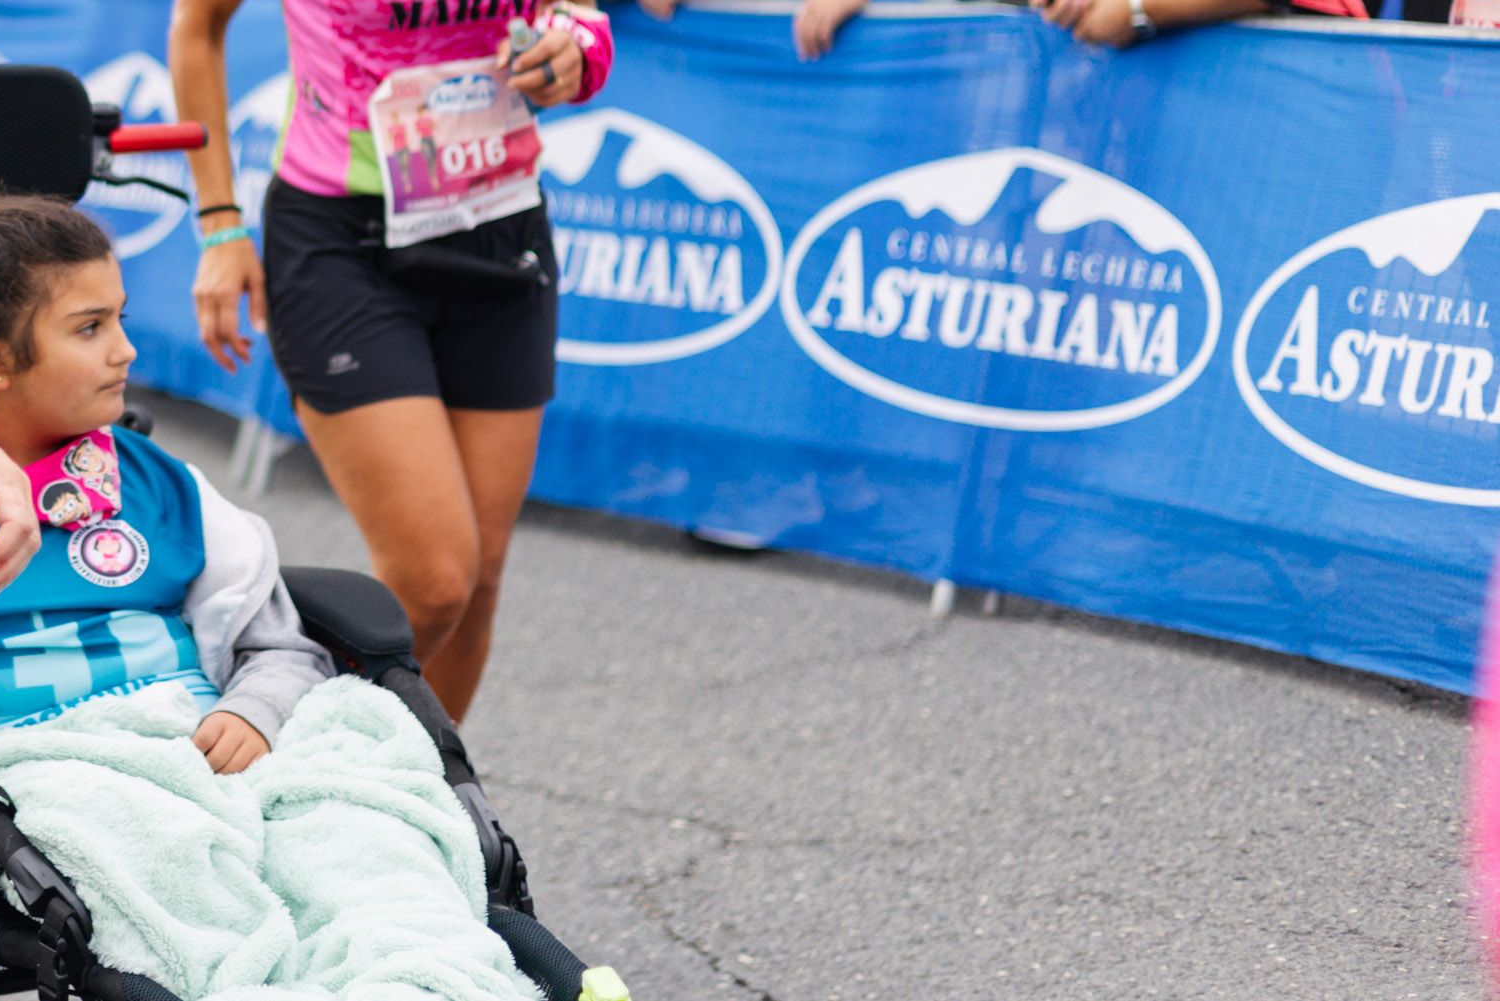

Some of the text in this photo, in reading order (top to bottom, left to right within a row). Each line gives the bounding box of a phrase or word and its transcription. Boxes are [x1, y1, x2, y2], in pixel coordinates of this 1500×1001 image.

[441, 137, 508, 176] 016
[620, 196, 744, 240] LECHERA
[553, 226, 746, 316] URIANA
[886, 229, 1184, 293] CENTRAL LECHERA
[807, 227, 1181, 378] ASTURIANA
[1346, 286, 1491, 329] CENTRAL
[1257, 284, 1500, 424] ASTUR
